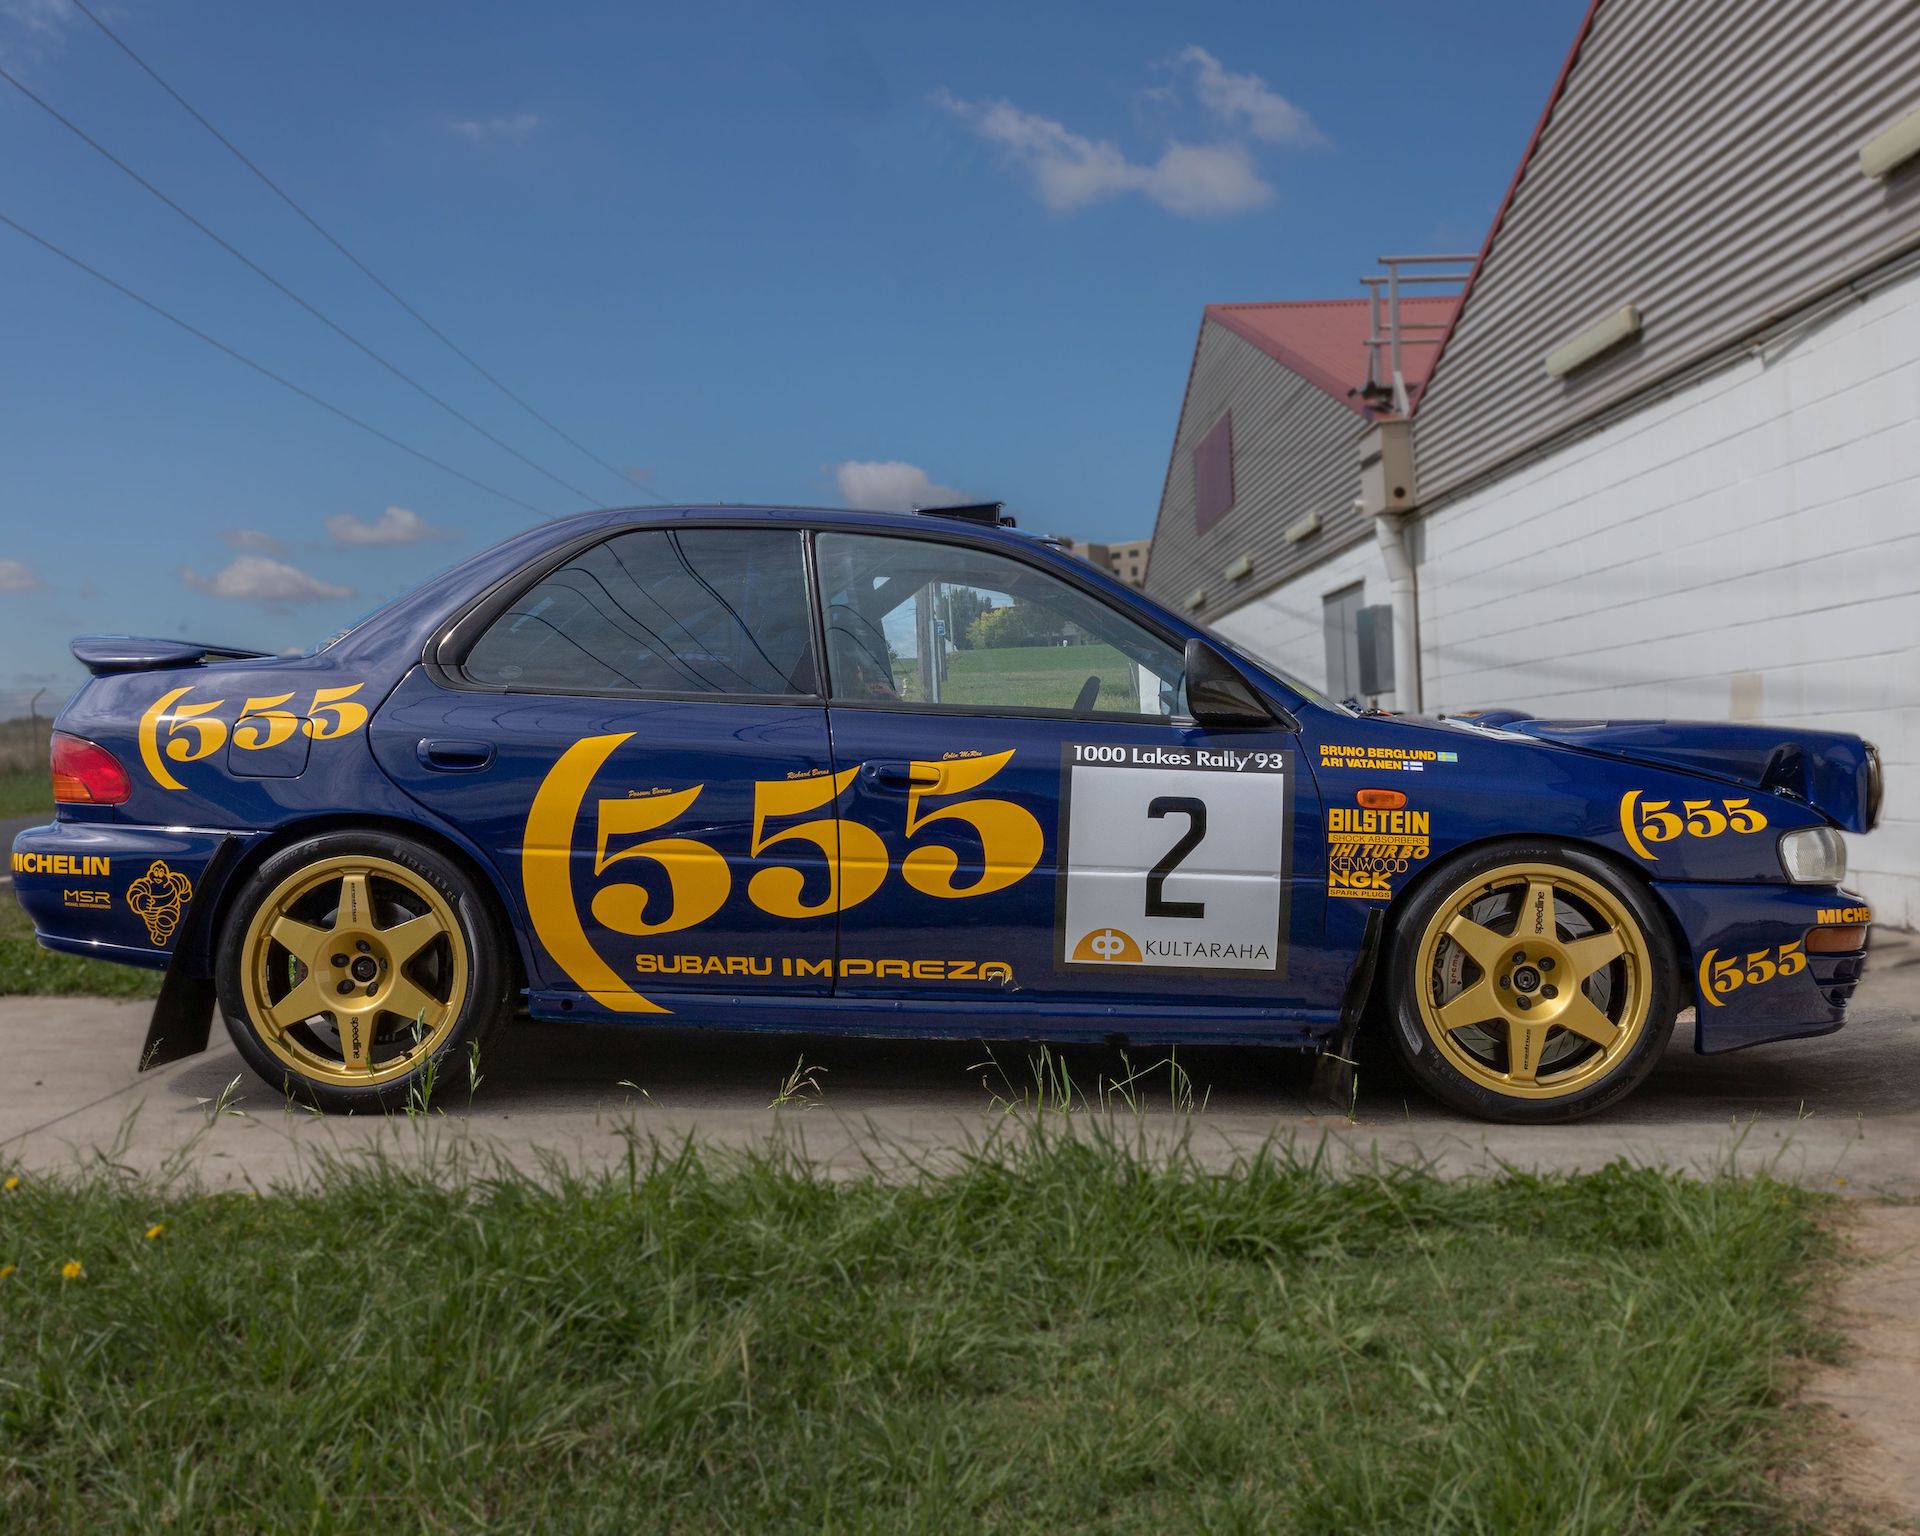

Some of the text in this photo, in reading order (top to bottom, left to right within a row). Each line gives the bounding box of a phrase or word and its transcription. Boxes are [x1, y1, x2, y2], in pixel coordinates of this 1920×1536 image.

[1073, 745, 1126, 763] 1000
[1132, 747, 1191, 766] Lakes
[1320, 744, 1437, 761] BRUNO BERGLUND
[1321, 758, 1402, 770] ARI VATANEN
[1328, 808, 1430, 835] BILSTEIN
[1332, 834, 1425, 845] SHOCK ABSORBERS
[1145, 796, 1207, 919] 2
[1328, 844, 1430, 860] IHI TURBO
[1328, 857, 1409, 873] KENWOOD
[1328, 871, 1392, 890] NGK
[63, 889, 111, 903] MSR
[1329, 889, 1390, 898] SPARK PLUGS
[1533, 890, 1545, 935] speedline
[1816, 906, 1872, 924] MICHE
[1145, 940, 1269, 960] KULTARAHA
[635, 953, 1013, 981] SUBARU IMPREZA
[351, 1016, 363, 1060] speedline
